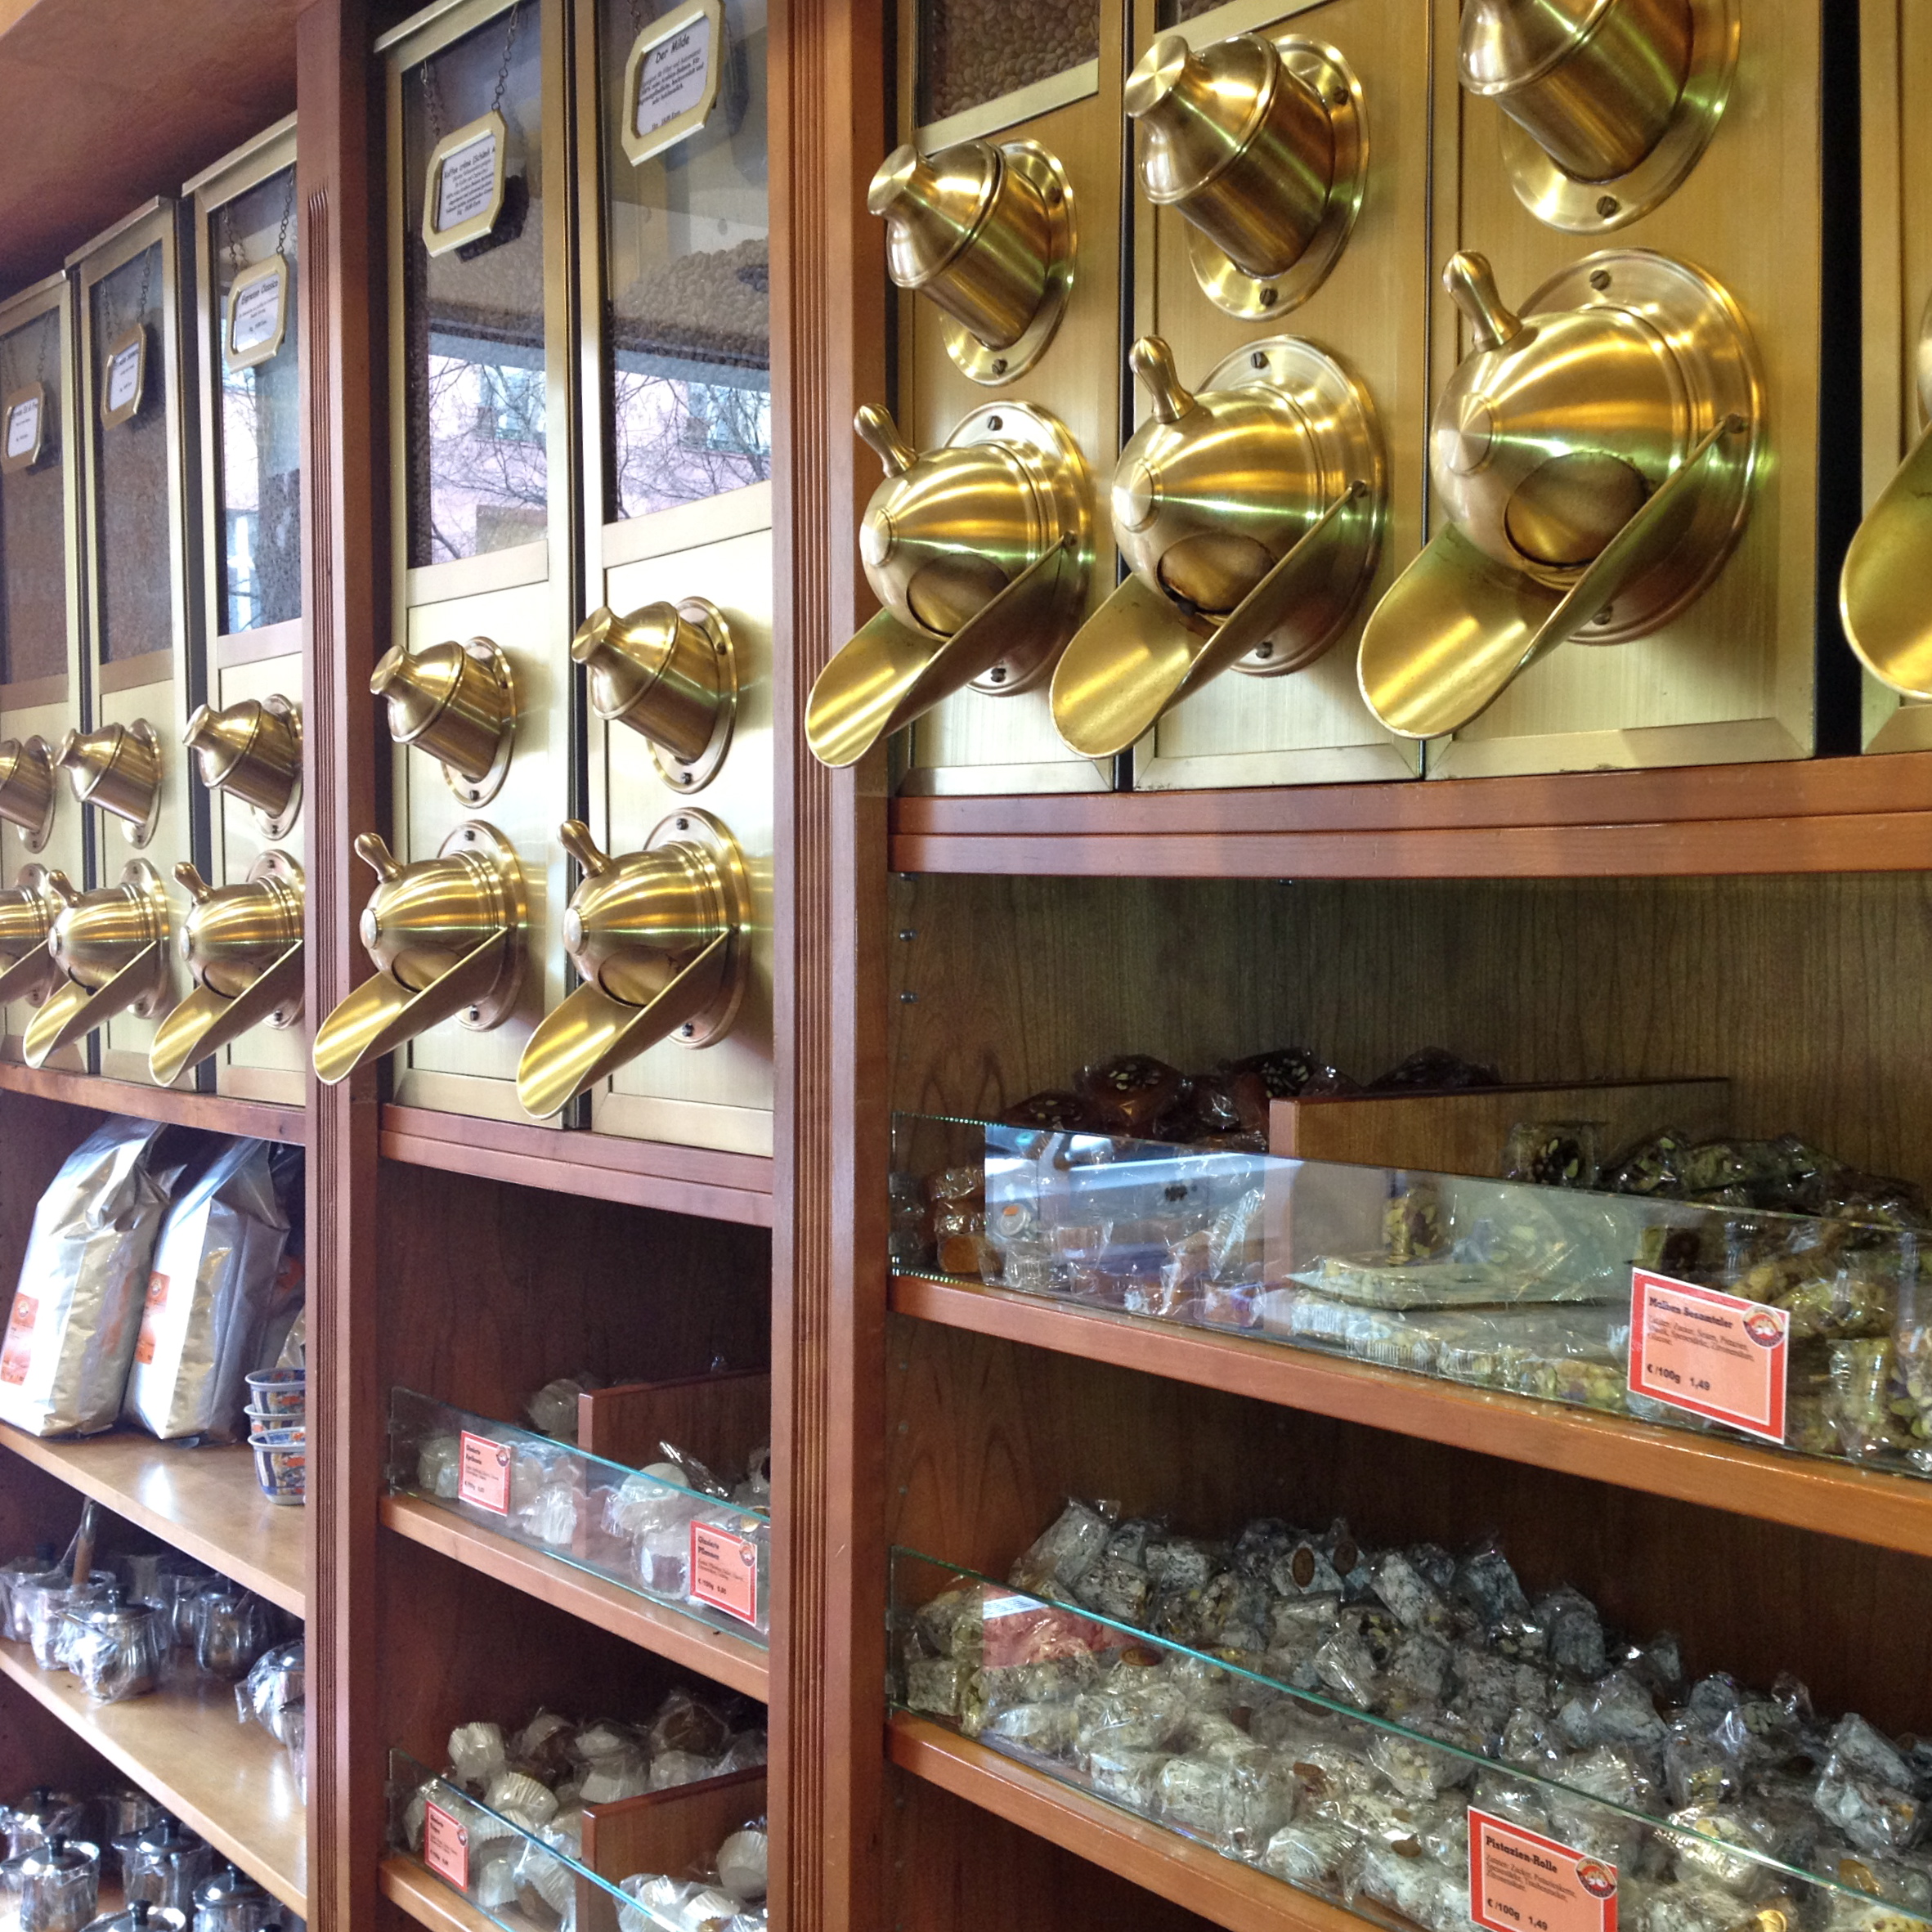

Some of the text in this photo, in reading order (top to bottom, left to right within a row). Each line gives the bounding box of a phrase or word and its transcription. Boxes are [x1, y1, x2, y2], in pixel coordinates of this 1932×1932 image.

[656, 49, 668, 63] Der
[671, 34, 690, 54] Milde
[1486, 1836, 1557, 1873] Pistazien-Rolle
[1495, 1900, 1520, 1921] /100g
[1528, 1916, 1548, 1930] 1,49
